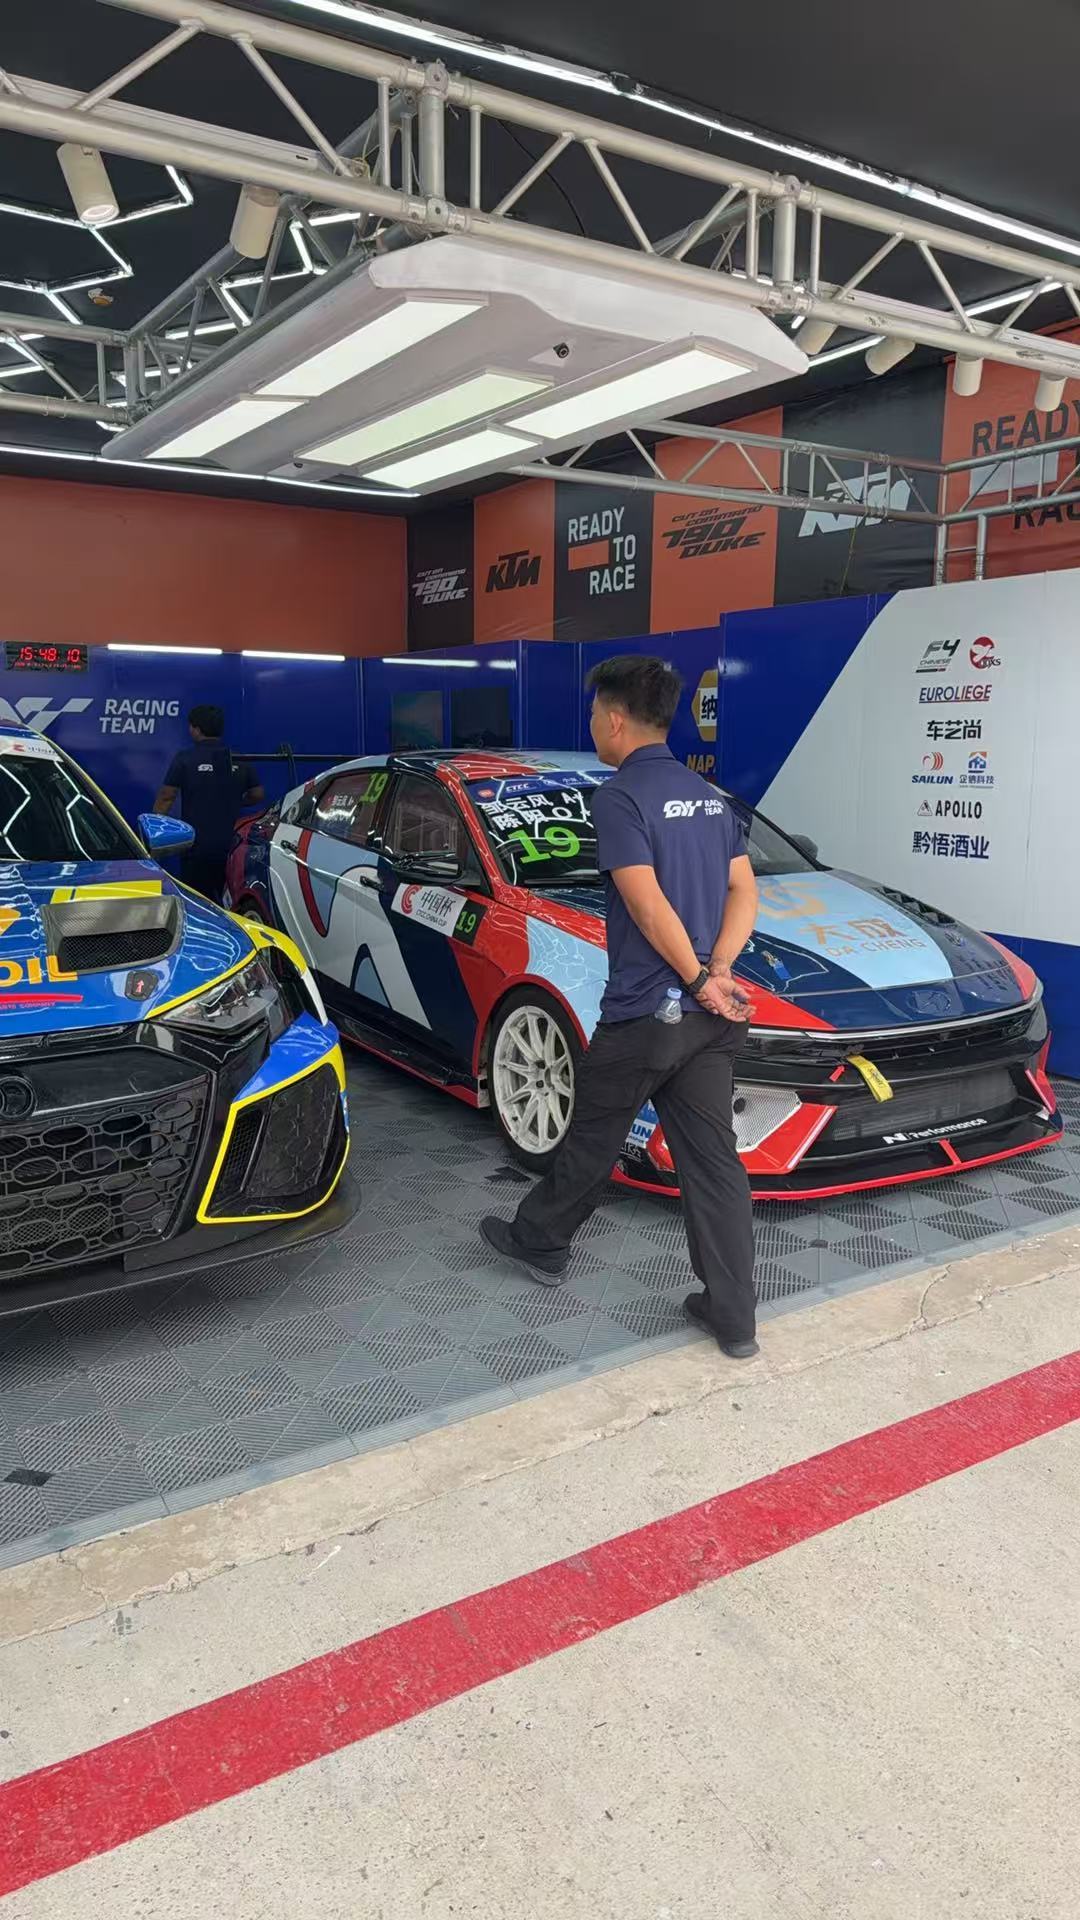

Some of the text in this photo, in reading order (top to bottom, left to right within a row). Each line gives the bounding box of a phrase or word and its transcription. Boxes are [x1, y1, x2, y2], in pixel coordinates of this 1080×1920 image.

[568, 506, 625, 543] READY
[672, 506, 720, 523] CUT ON
[686, 505, 764, 526] COMMAND
[661, 516, 748, 549] 790
[613, 534, 636, 562] TO
[679, 532, 766, 559] DUKE
[484, 549, 542, 593] KTM
[589, 564, 635, 595] RACE
[412, 575, 459, 597] 790
[422, 587, 469, 605] DUKE
[923, 639, 960, 659] F4
[919, 658, 952, 666] CHINESE
[919, 684, 992, 701] EUROLIEGE
[104, 699, 180, 717] RACING
[99, 717, 156, 734] TEAM
[926, 719, 982, 741] 车艺尚
[687, 754, 717, 774] NAP
[361, 772, 389, 803] 19
[912, 775, 953, 785] SAILUN
[935, 800, 982, 819] APOLLO
[508, 826, 580, 864] 19
[912, 831, 990, 859] 黔悟酒业
[420, 890, 457, 917] 中国杯
[456, 910, 477, 933] 19
[861, 936, 928, 953] CHENG
